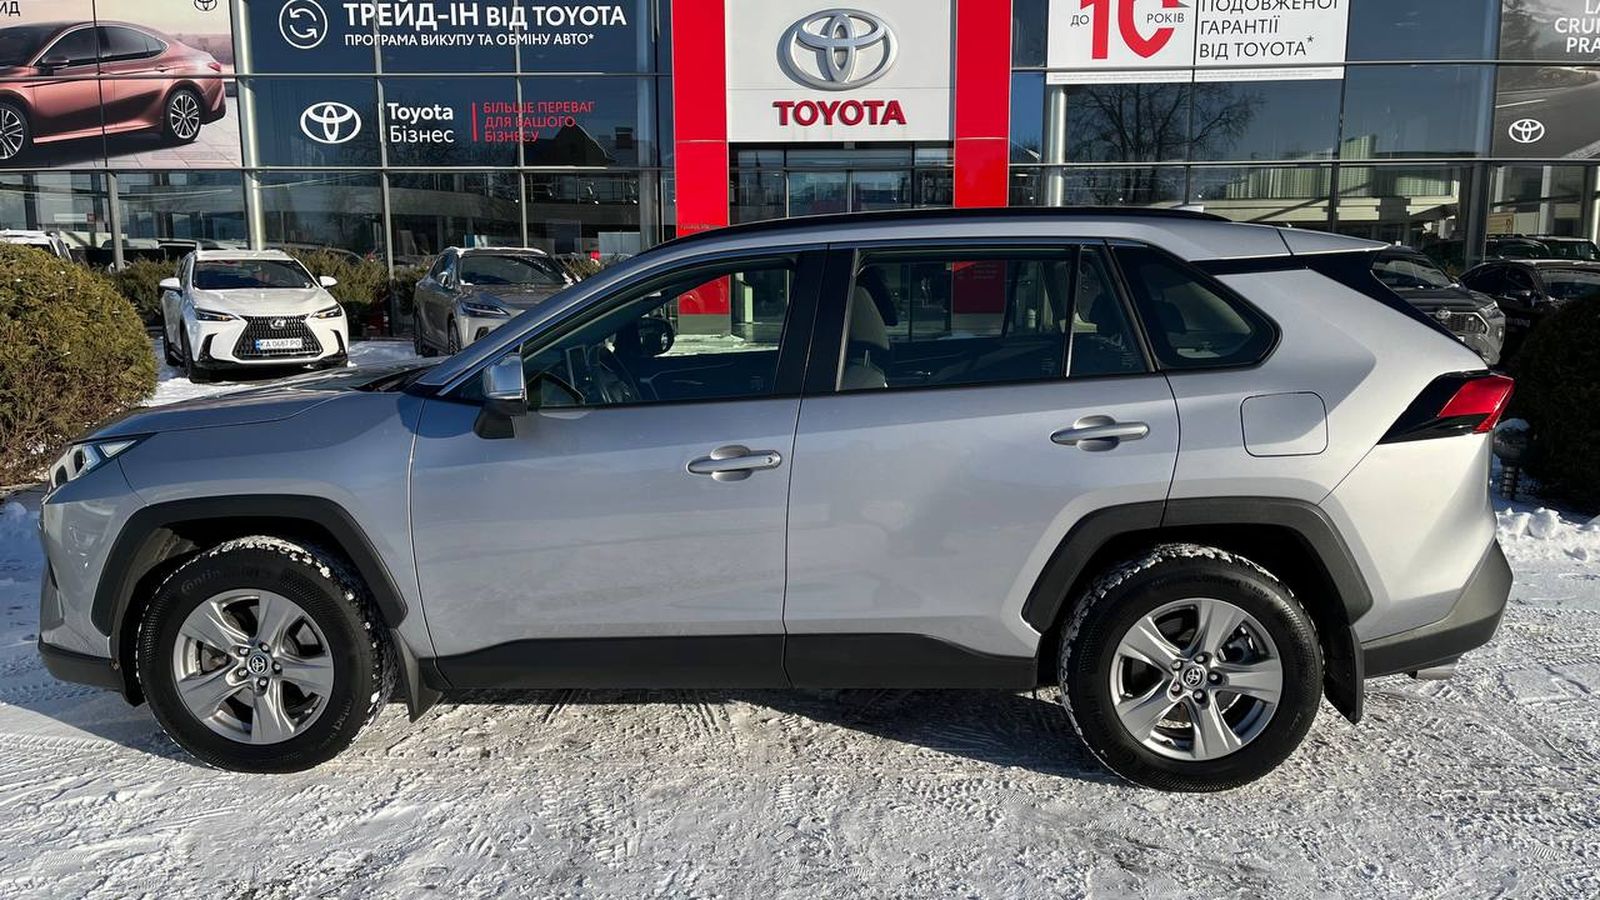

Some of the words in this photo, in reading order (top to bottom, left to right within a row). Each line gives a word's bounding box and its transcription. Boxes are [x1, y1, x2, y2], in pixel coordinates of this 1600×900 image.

[343, 0, 478, 31] ТРЕЙД-ІН
[486, 6, 528, 31] ВІД
[532, 6, 627, 26] TOYOTA
[1070, 14, 1090, 27] ДО
[1146, 13, 1185, 24] РОКІВ
[1200, 15, 1280, 35] ГАРАНТІЇ
[344, 34, 418, 46] ПРОГРАМА
[420, 34, 475, 46] ВИКУПУ
[477, 34, 494, 46] ТА
[496, 34, 551, 46] ОБМІНУ
[1199, 43, 1229, 60] ВІД
[387, 103, 454, 122] Toyota
[483, 101, 535, 113] БІЛЬШЕ
[537, 101, 595, 113] ПЕРЕВАГ
[772, 100, 906, 127] TOYOTA
[485, 116, 512, 129] ДЛЯ
[515, 116, 576, 127] ВАШОГО
[390, 125, 455, 144] Бізнес
[484, 131, 539, 143] БІЗНЕСУ
